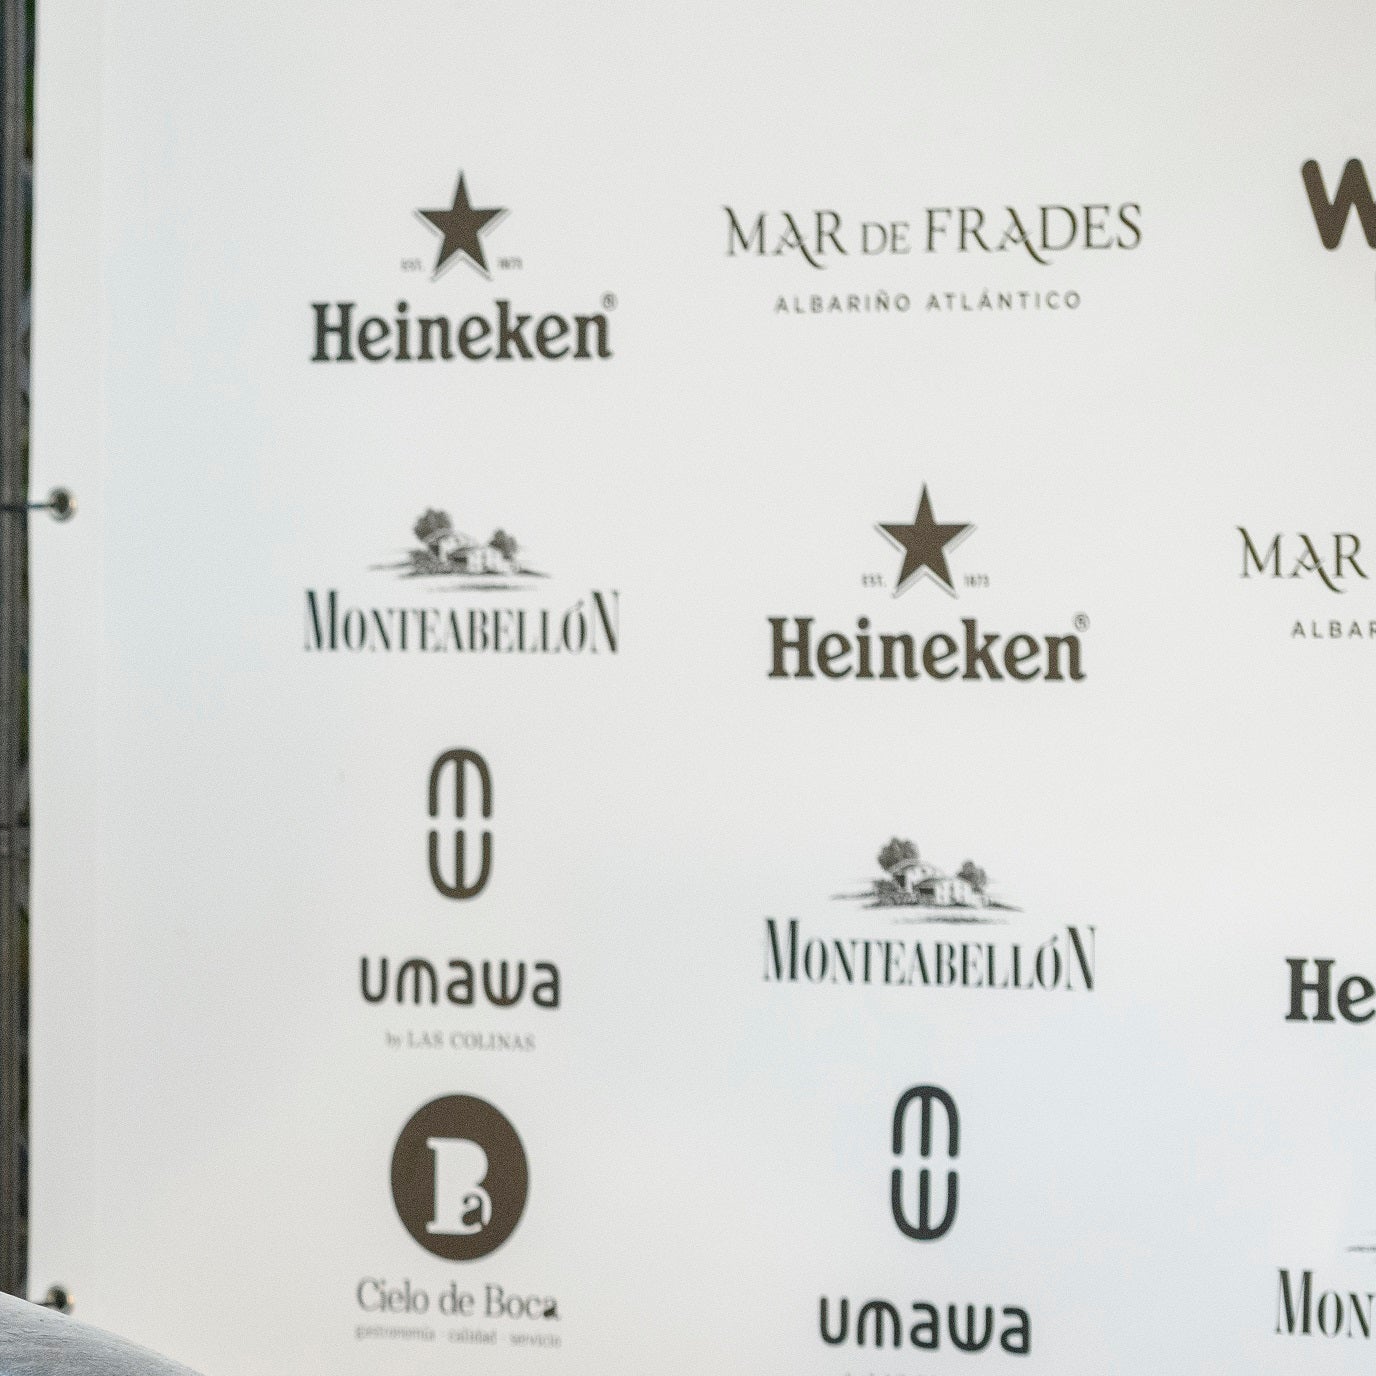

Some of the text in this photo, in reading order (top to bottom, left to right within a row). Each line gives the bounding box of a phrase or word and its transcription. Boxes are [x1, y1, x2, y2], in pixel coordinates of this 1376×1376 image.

[722, 201, 1143, 269] MAR DE FRADES
[309, 298, 614, 363] Heineken
[773, 287, 1083, 315] ALBARIÑO ATLÁNTICO
[1235, 523, 1370, 595] MAR
[766, 613, 1087, 682] Heineken
[407, 1030, 445, 1049] LAS
[449, 1031, 537, 1053] COLINAS
[355, 1275, 563, 1322] Cielo de Boca
